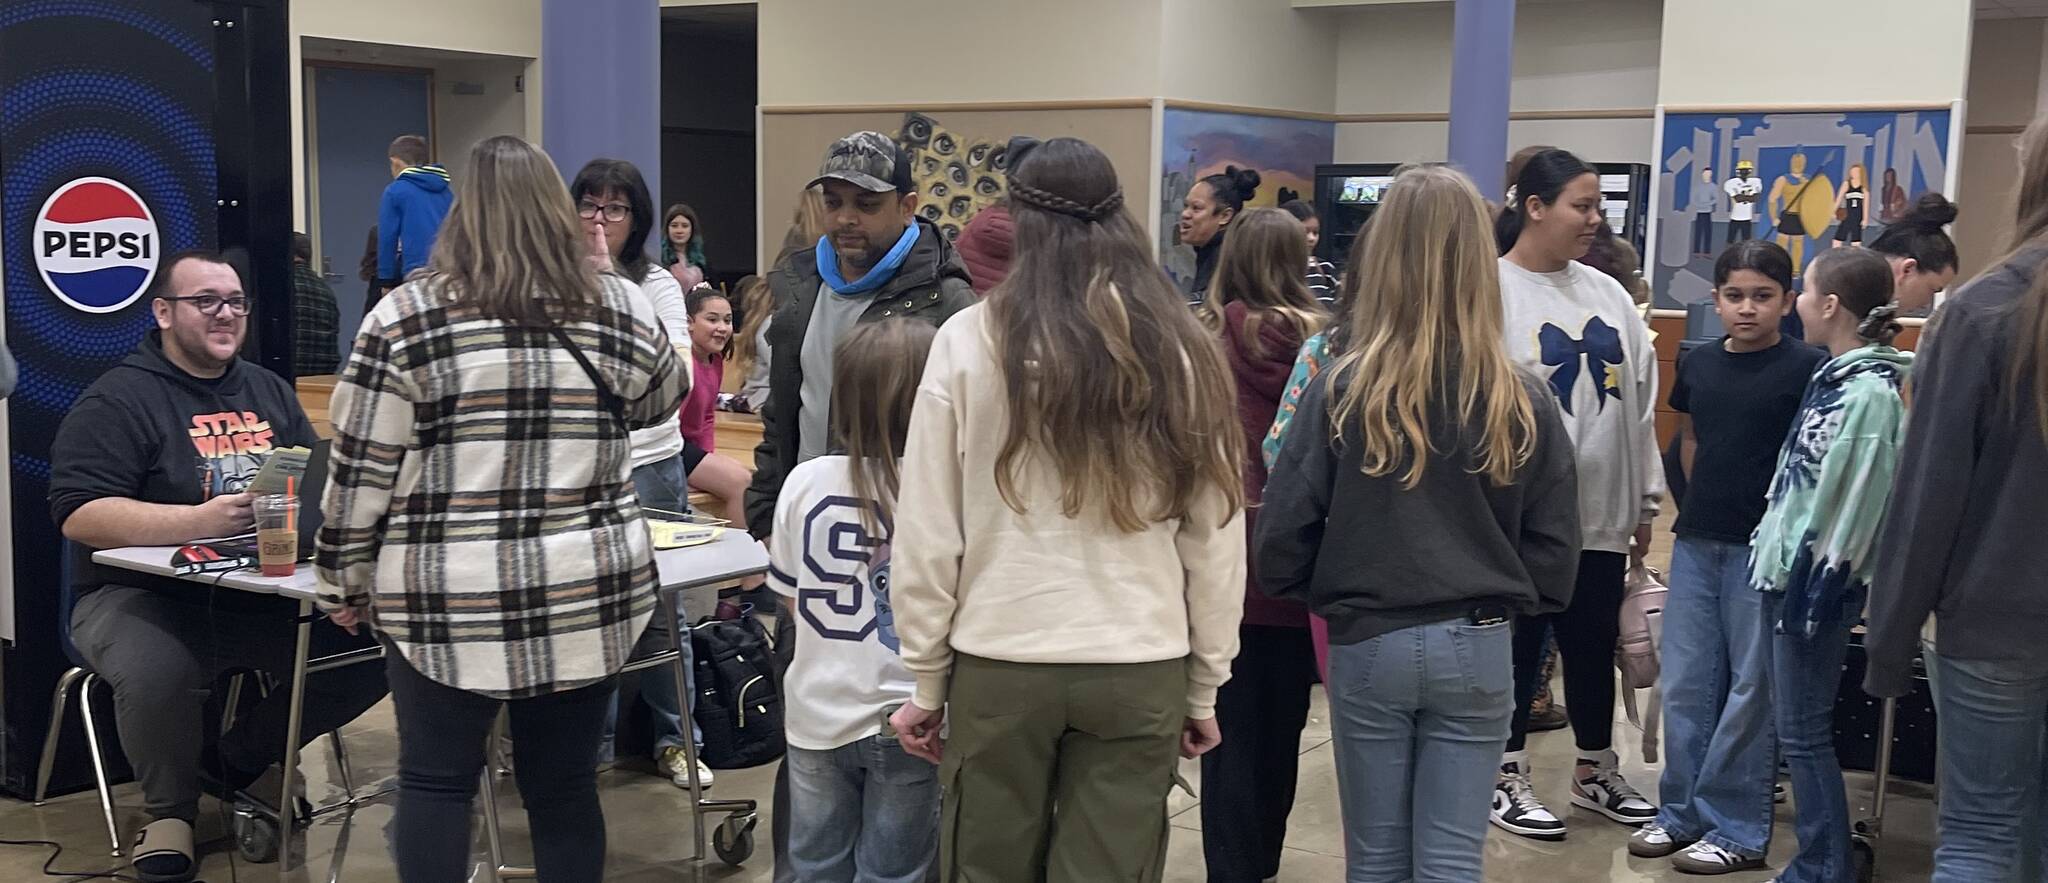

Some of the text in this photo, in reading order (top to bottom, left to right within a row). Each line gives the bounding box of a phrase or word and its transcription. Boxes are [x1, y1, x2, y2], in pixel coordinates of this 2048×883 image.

[43, 230, 151, 260] PEPSI
[188, 411, 271, 437] STAR
[192, 429, 274, 458] WARS
[798, 494, 895, 642] S
